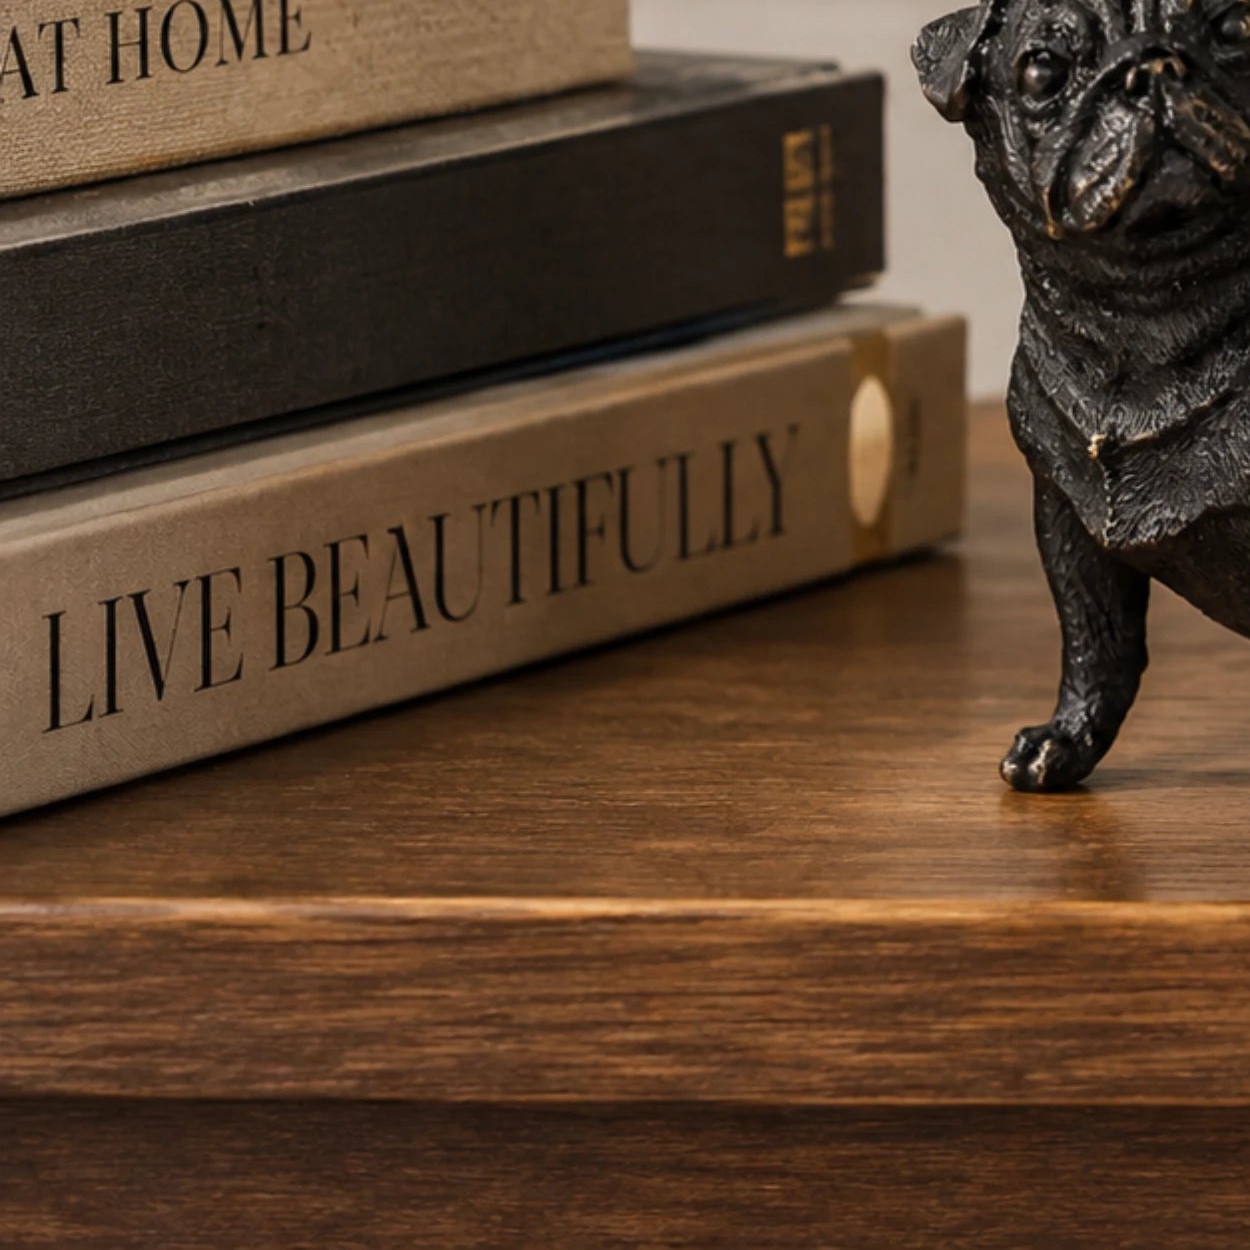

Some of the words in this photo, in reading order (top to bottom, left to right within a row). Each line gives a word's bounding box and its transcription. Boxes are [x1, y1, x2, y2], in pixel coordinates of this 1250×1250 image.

[0, 17, 81, 99] AT
[42, 567, 244, 732] LIVE
[268, 423, 799, 671] BEAUTIFULLY
